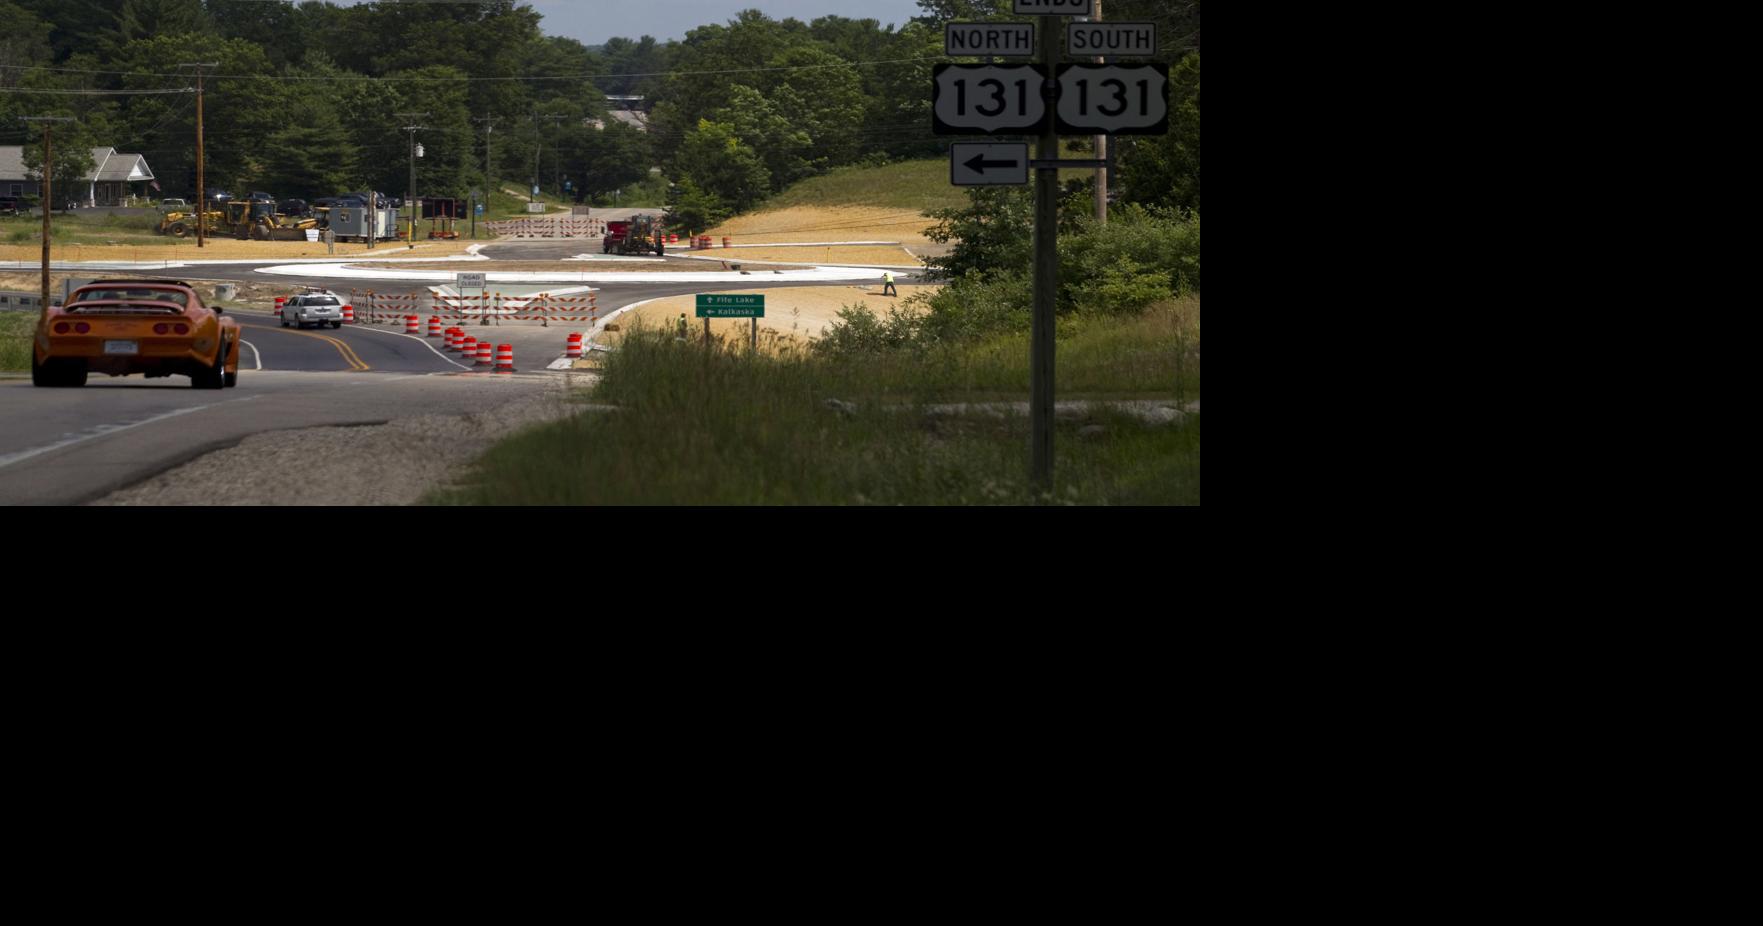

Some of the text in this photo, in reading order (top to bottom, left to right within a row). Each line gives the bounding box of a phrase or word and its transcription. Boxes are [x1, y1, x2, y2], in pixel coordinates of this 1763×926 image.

[951, 29, 1030, 49] NORTH
[1073, 29, 1150, 49] SOUTH
[954, 78, 1027, 117] 131
[1076, 78, 1149, 117] 131
